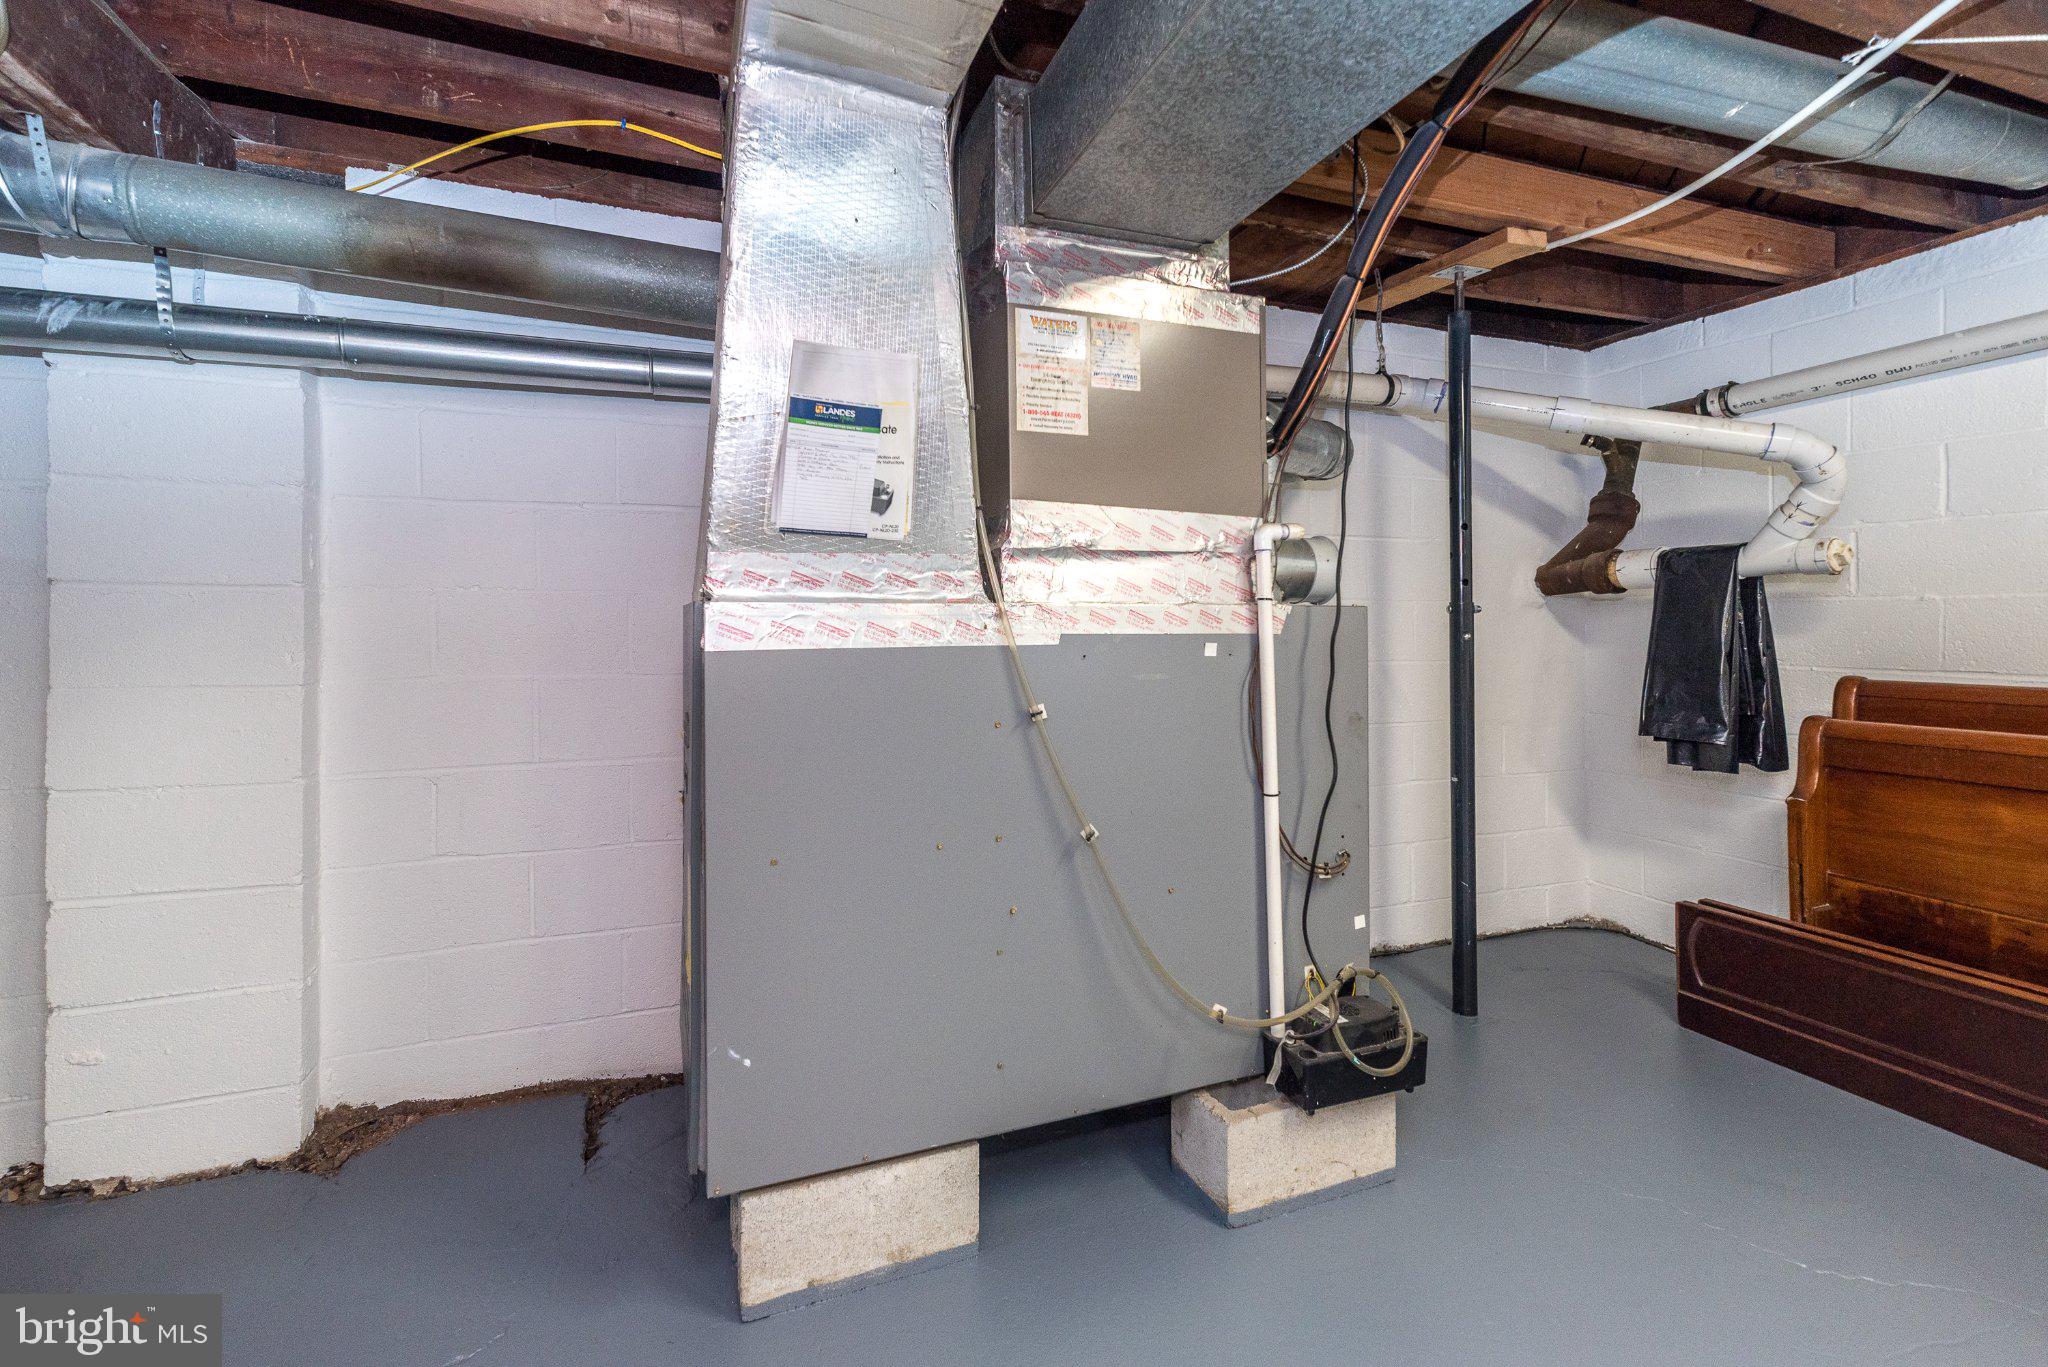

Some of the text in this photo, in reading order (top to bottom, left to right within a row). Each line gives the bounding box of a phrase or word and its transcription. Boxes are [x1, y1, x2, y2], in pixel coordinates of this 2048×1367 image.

[1030, 315, 1078, 331] WATERS
[1732, 397, 1767, 410] EAGLE
[1835, 373, 1877, 387] SCH40
[823, 406, 856, 417] LANDES
[882, 425, 898, 435] ate
